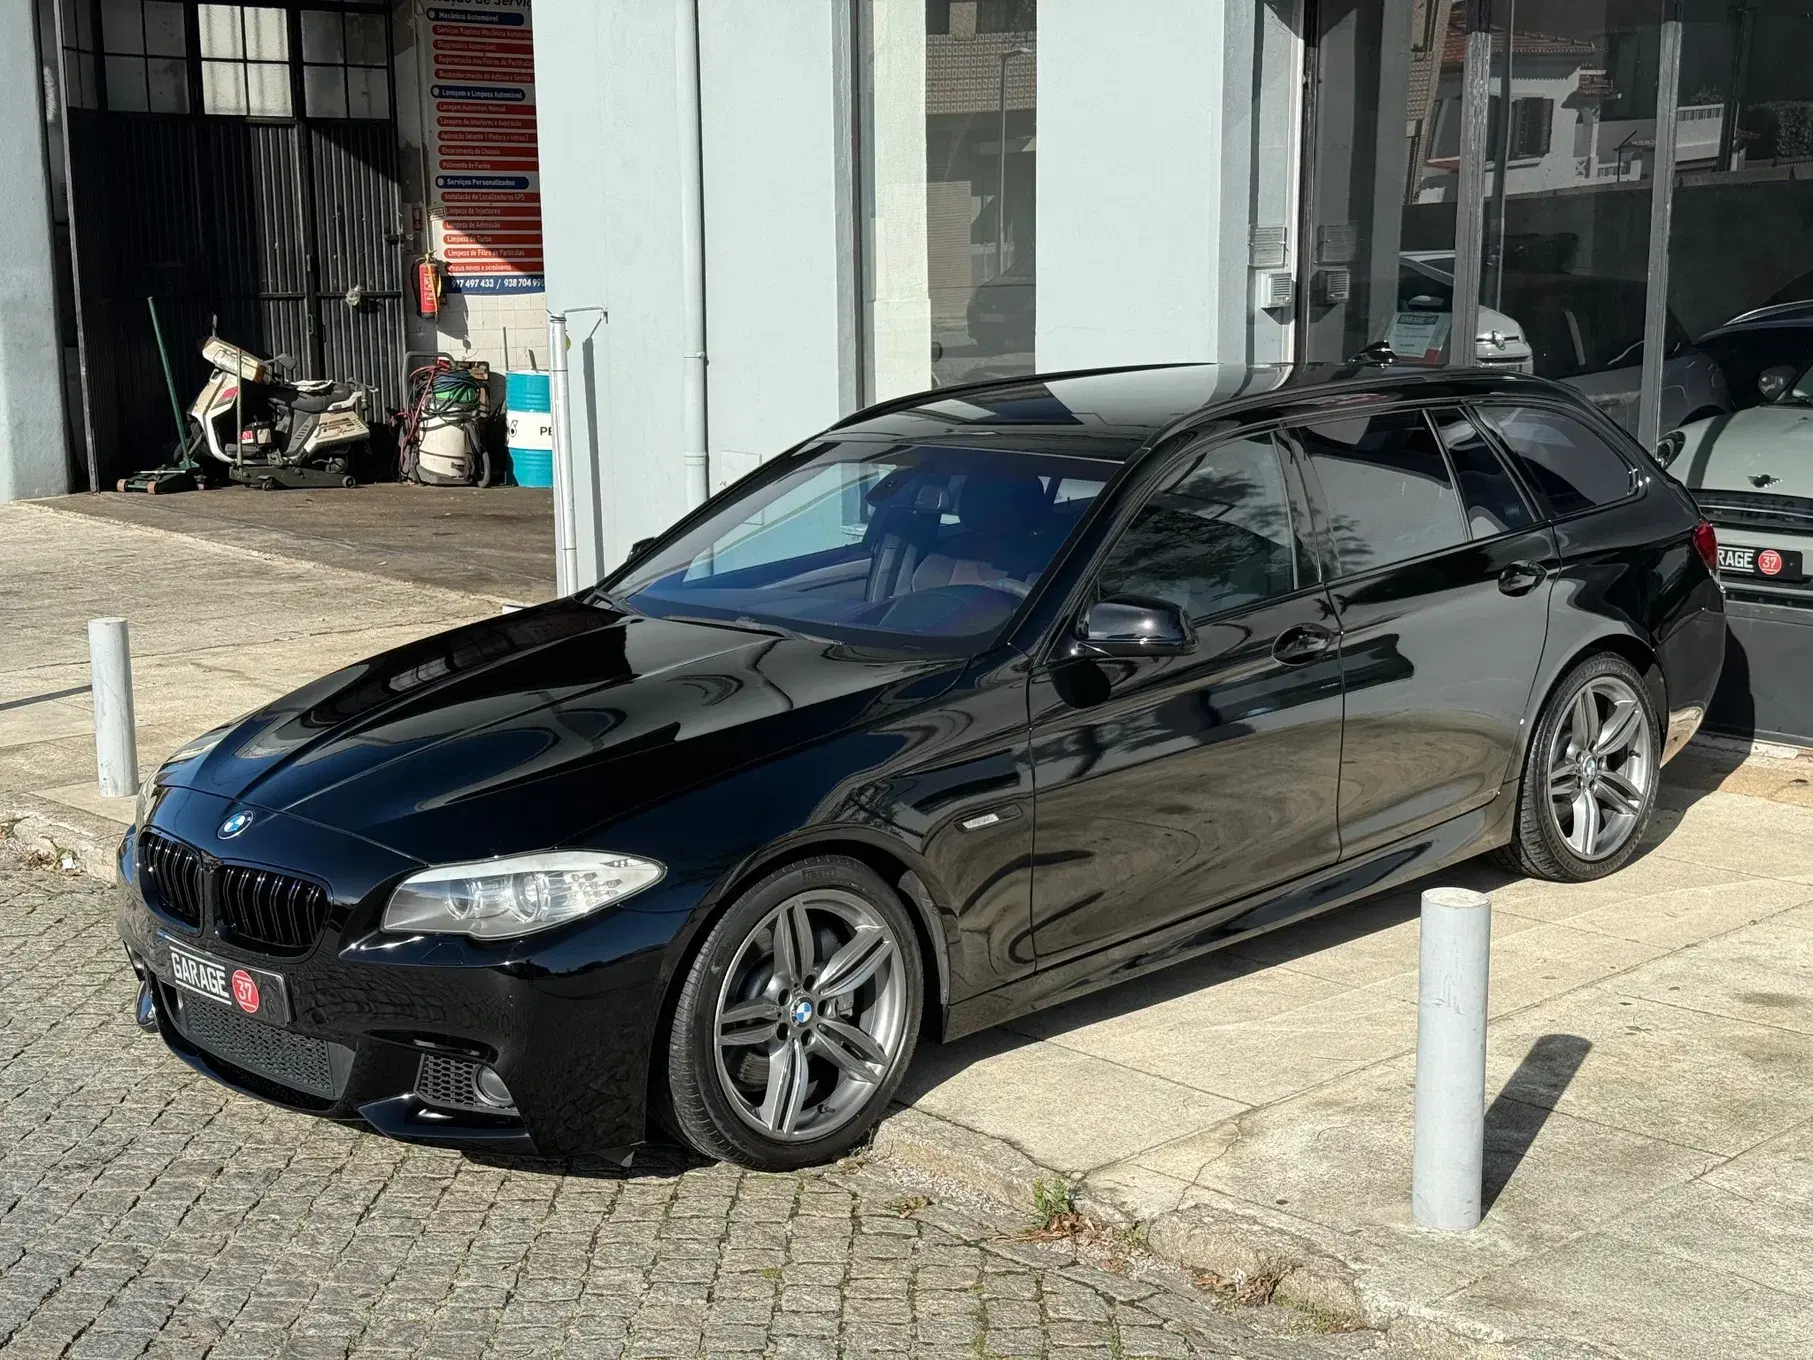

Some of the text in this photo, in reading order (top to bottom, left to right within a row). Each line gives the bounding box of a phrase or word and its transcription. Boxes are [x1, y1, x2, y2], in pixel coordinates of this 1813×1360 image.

[438, 11, 500, 22] Mecânica Automóvel
[468, 43, 497, 51] Automóvel
[442, 89, 466, 98] Lavagem
[470, 90, 493, 99] Limpeza
[494, 91, 523, 99] Automóvel
[440, 104, 462, 112] Lavagem
[440, 118, 462, 126] Lavagem
[441, 133, 465, 141] Aplicação
[447, 178, 516, 187] Serviços Personalizados
[445, 193, 471, 201] Instalação
[446, 207, 467, 215] Limpeza
[446, 221, 468, 229] Limpeza
[447, 235, 469, 243] Limpeza
[447, 249, 470, 258] Limpeza
[464, 279, 480, 288] 497
[480, 279, 494, 287] 433
[496, 278, 502, 289] /
[503, 278, 517, 288] 938
[518, 278, 532, 287] 704
[1762, 556, 1777, 569] 37
[171, 951, 252, 1002] GARAGE 37
